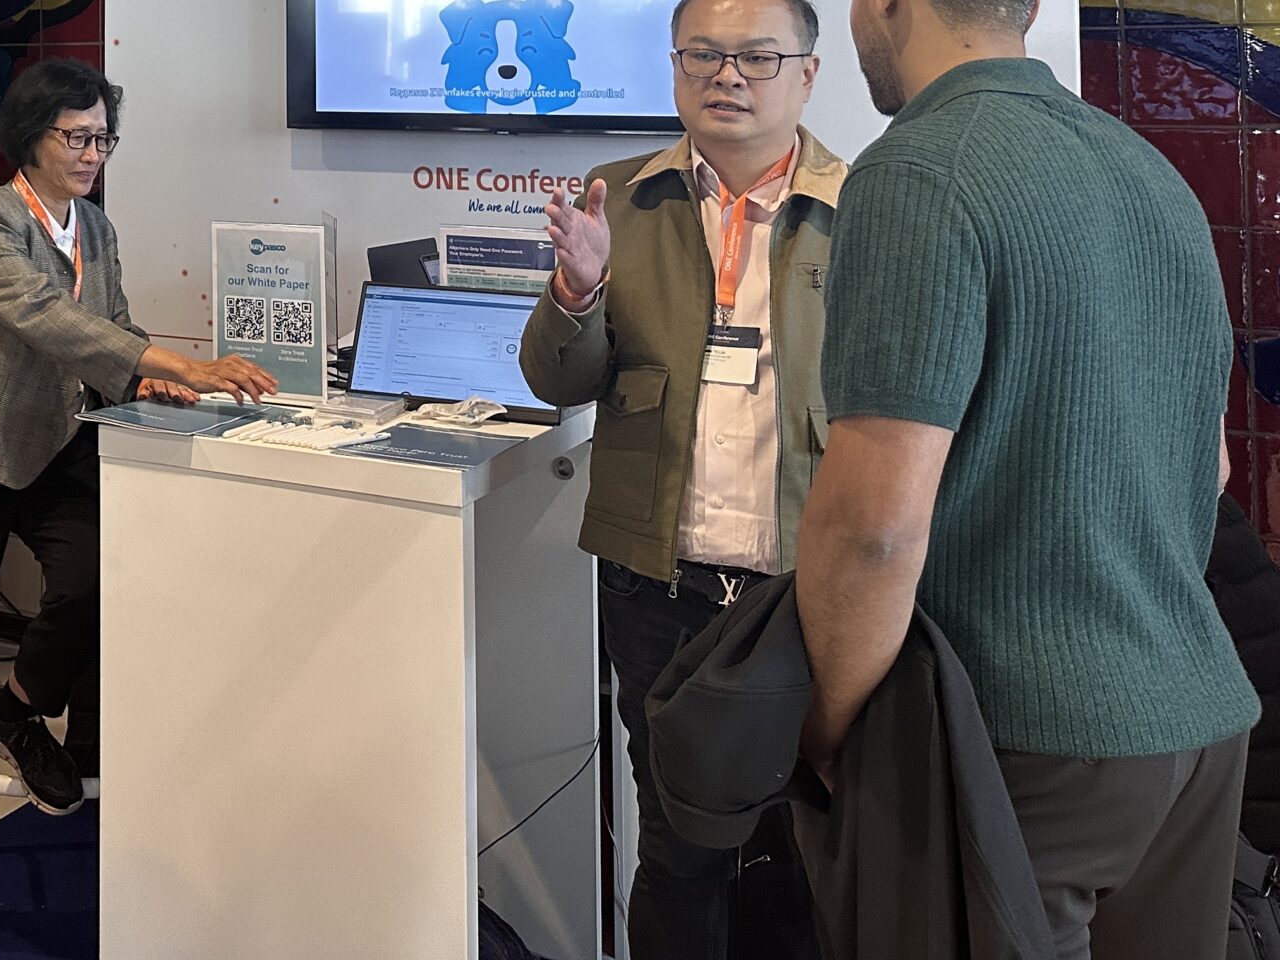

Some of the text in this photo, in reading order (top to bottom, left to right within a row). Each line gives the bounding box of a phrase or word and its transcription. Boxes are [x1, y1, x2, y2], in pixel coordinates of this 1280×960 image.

[524, 87, 556, 98] trusted
[558, 88, 576, 98] and
[413, 166, 585, 195] ONE Confere
[468, 198, 485, 212] We
[486, 203, 502, 213] are
[504, 199, 521, 214] all
[246, 263, 289, 275] Scan for
[227, 276, 310, 291] our White Paper
